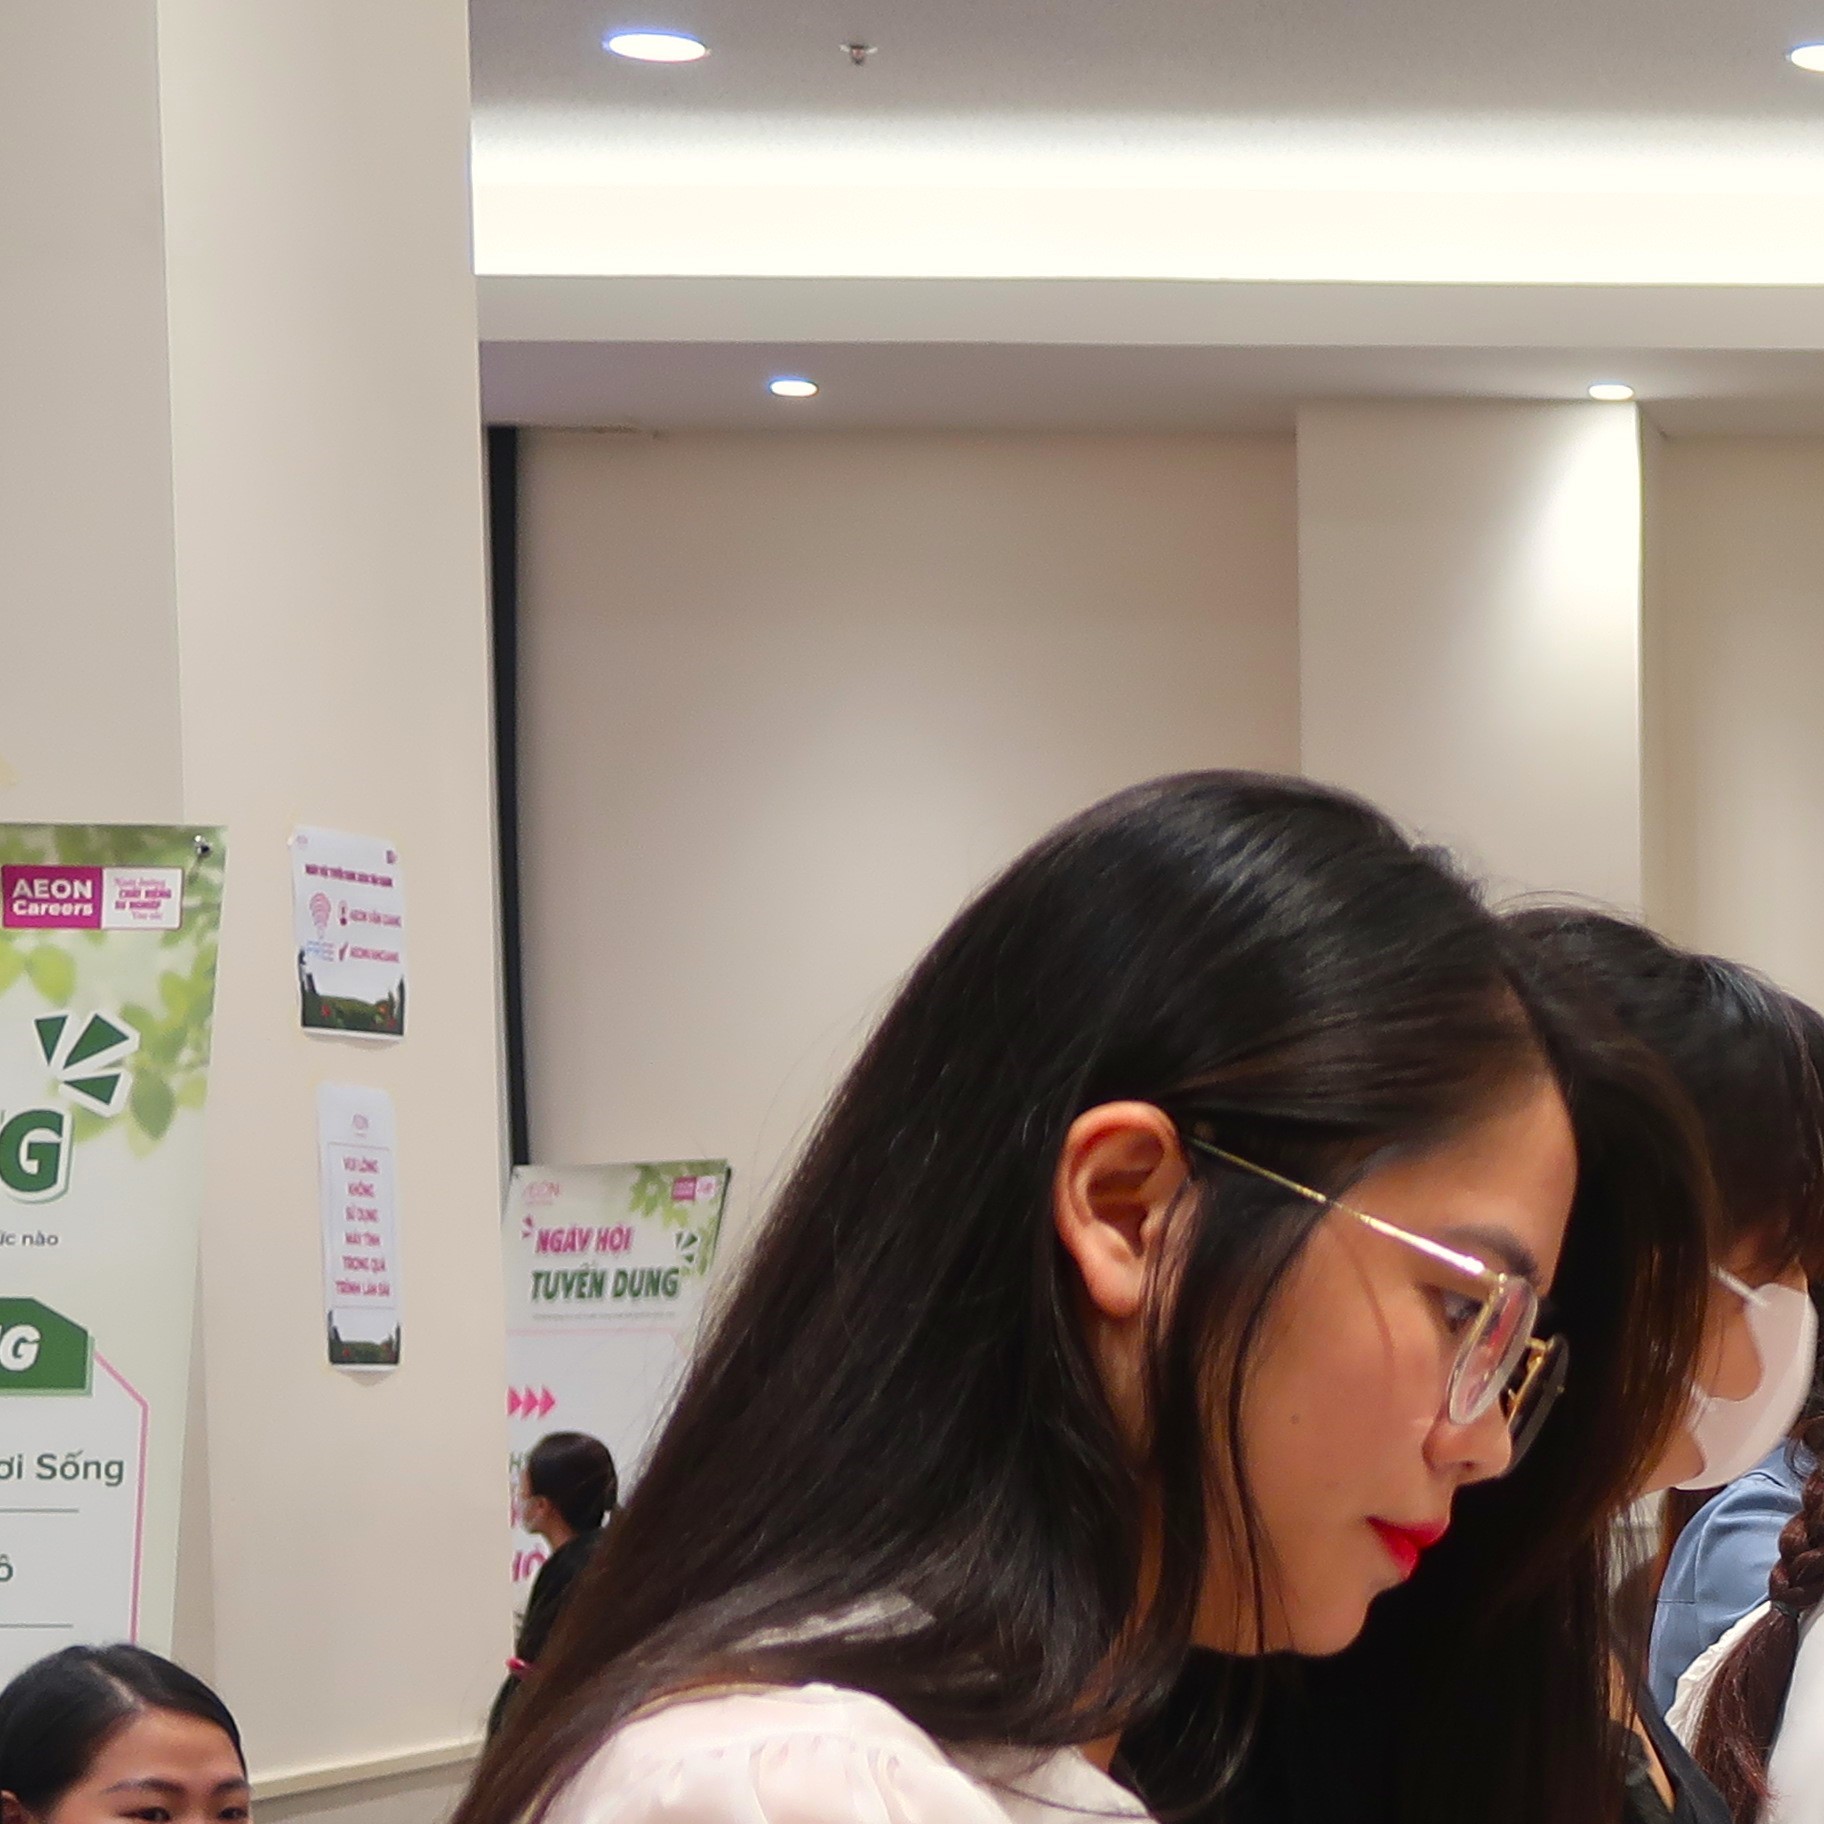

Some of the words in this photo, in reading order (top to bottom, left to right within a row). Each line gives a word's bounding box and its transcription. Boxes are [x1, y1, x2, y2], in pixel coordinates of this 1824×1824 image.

[12, 878, 93, 899] AEON
[12, 900, 93, 916] Careers
[0, 1110, 64, 1192] G
[22, 1228, 58, 1246] nào
[536, 1225, 592, 1254] NGÀY
[595, 1223, 634, 1258] HỘI
[0, 1325, 41, 1371] G
[36, 1450, 124, 1488] Sống
